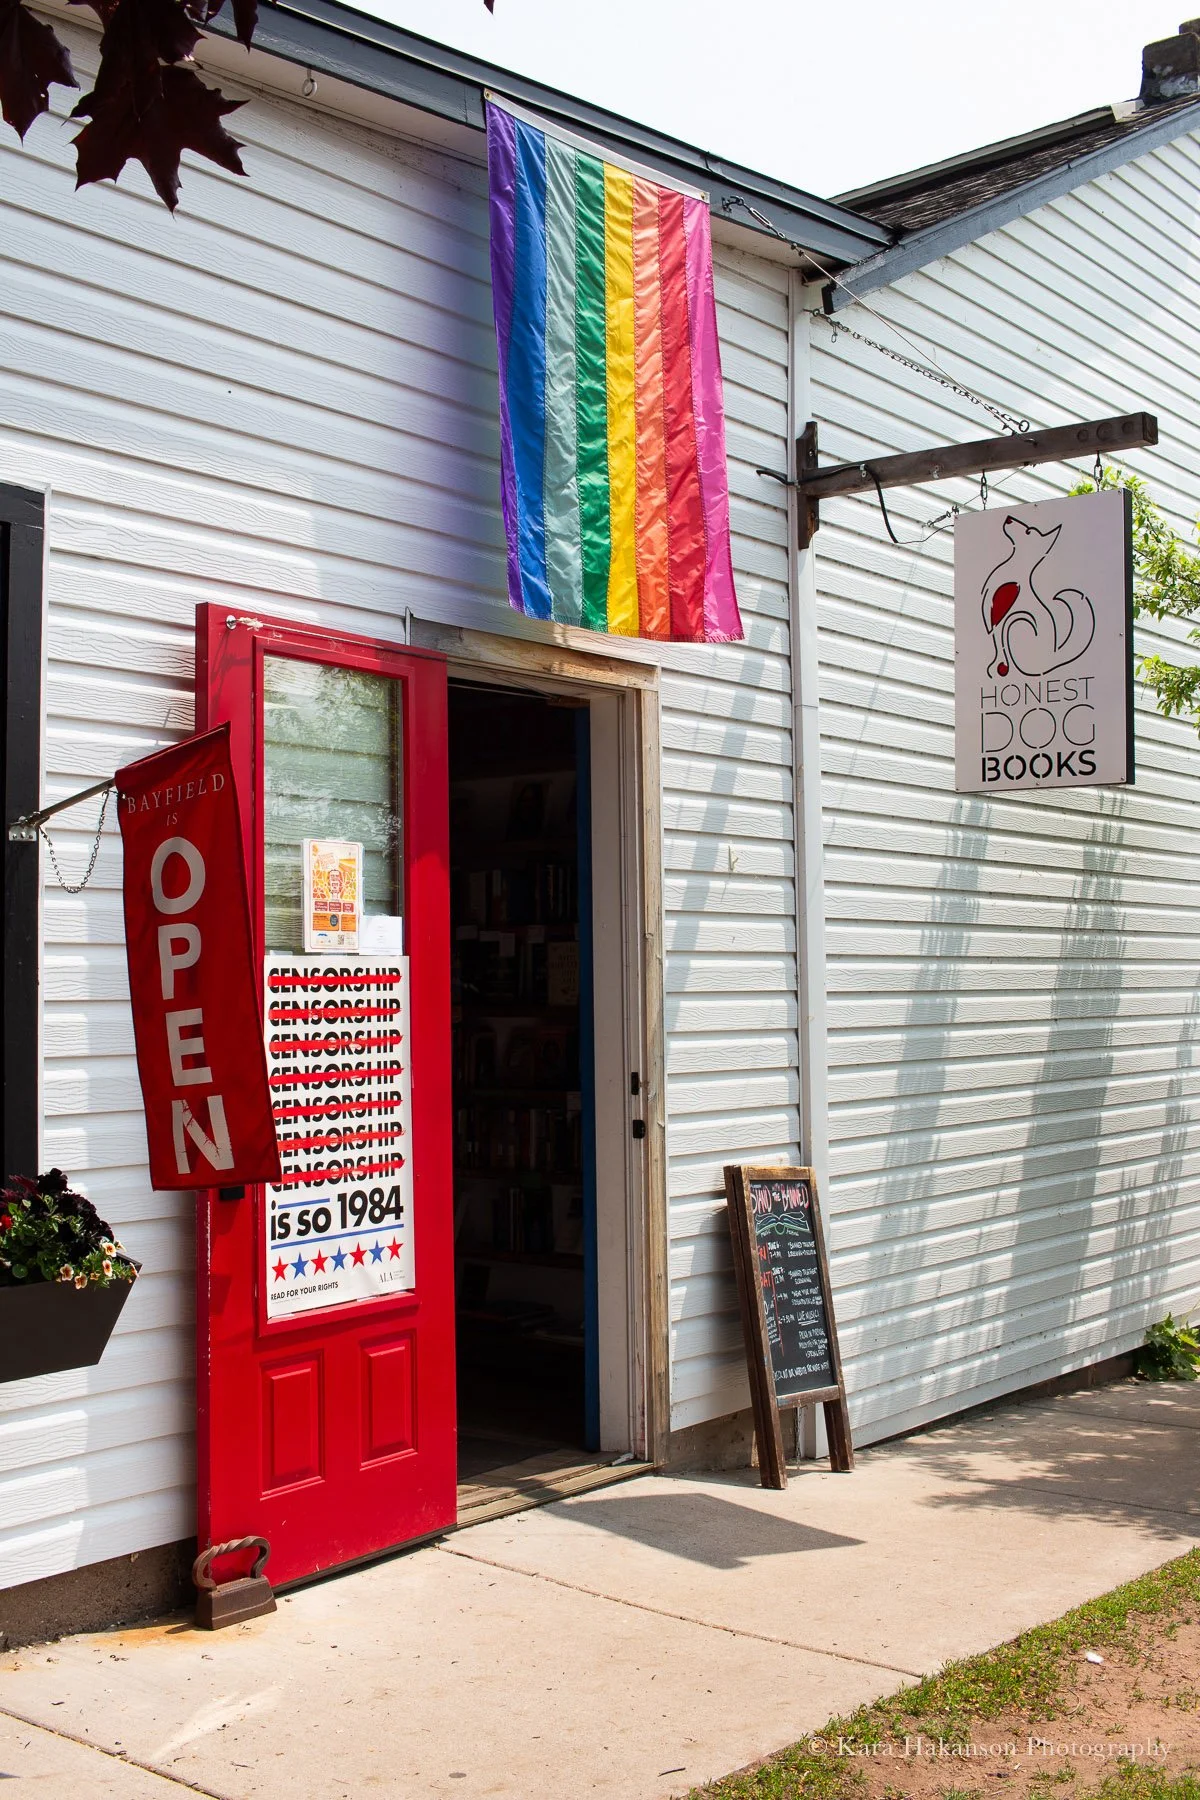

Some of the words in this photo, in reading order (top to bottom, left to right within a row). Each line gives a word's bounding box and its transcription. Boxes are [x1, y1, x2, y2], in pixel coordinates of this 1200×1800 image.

[980, 676, 1096, 709] HONEST
[981, 703, 1096, 754] DOG
[981, 749, 1097, 782] BOOKS
[127, 773, 225, 814] BAYFIELD
[166, 812, 178, 826] IS
[268, 967, 401, 994] CENSORSHIP
[150, 836, 236, 1175] OPEN
[269, 998, 401, 1027] CENSORSHIP
[270, 1028, 402, 1060] CENSORSHIP
[270, 1060, 402, 1093] CENSORSHIP
[276, 1121, 403, 1158] ENSORSHIP
[271, 1152, 404, 1193] ENSORSHIP
[271, 1200, 291, 1241] is
[296, 1206, 332, 1237] so
[337, 1184, 404, 1230] 1984
[270, 1289, 286, 1301] READ
[286, 1288, 299, 1298] FOR
[299, 1285, 318, 1296] YOUR
[317, 1281, 339, 1292] RIGHTS
